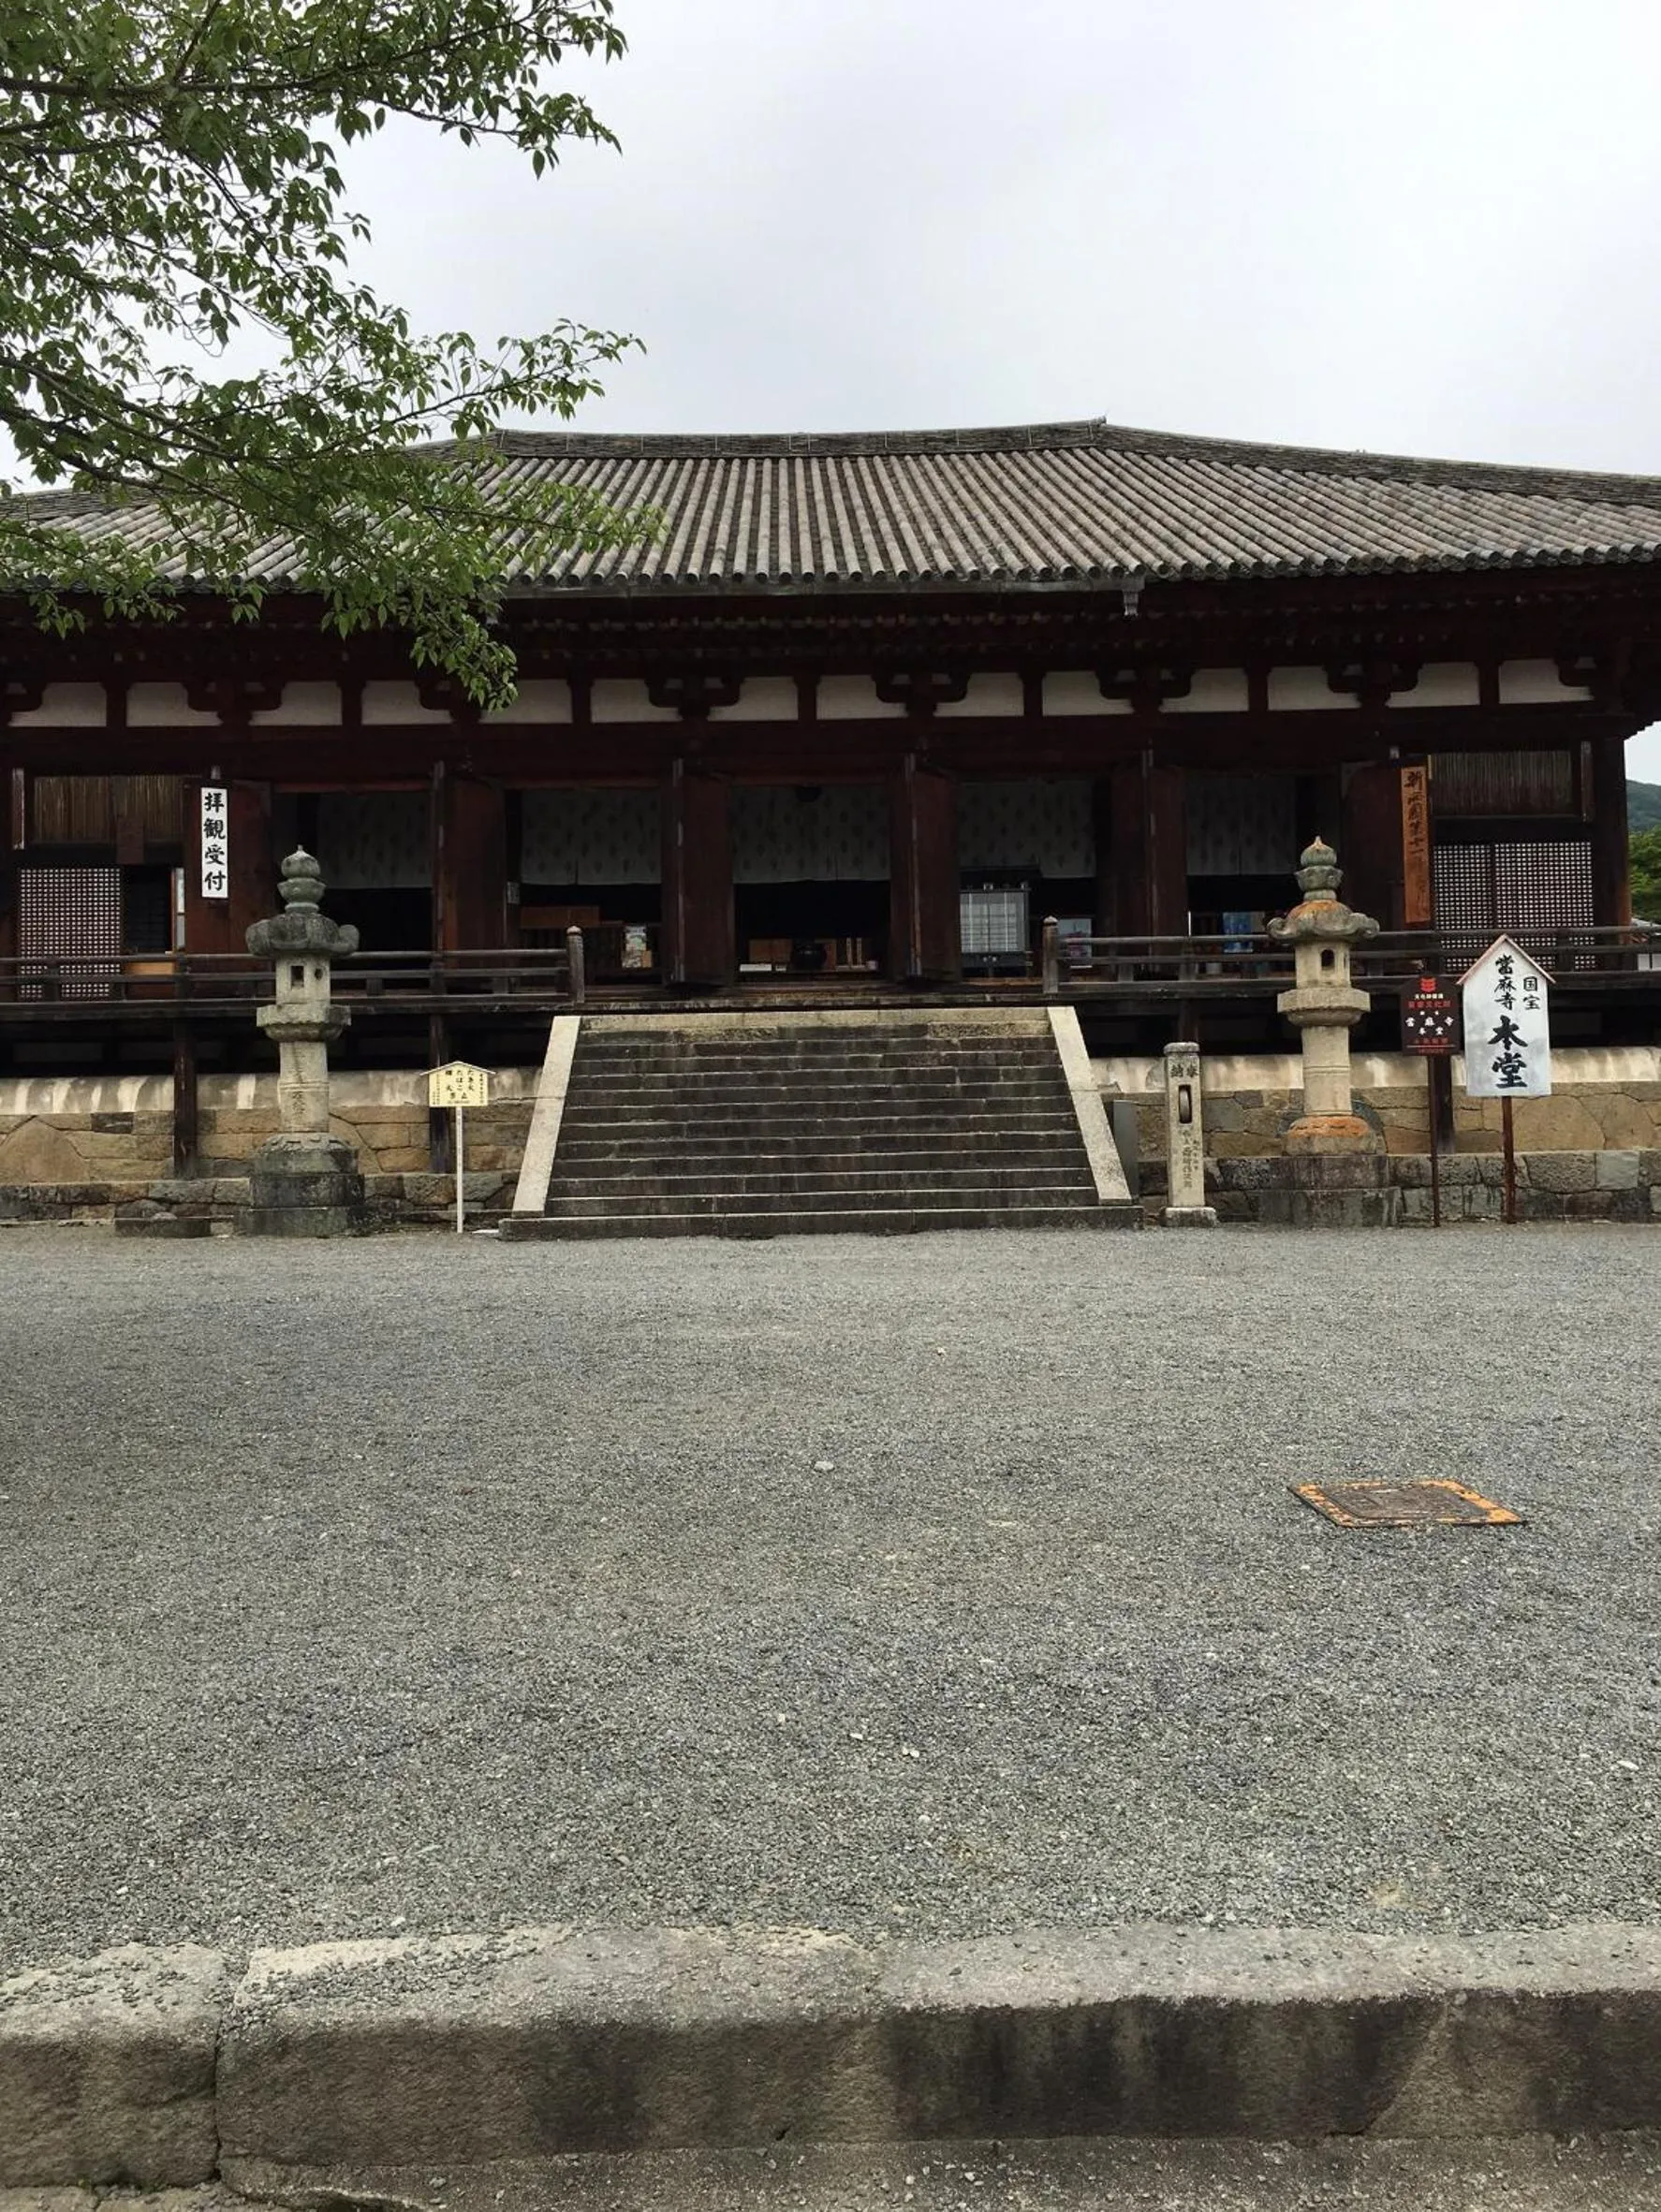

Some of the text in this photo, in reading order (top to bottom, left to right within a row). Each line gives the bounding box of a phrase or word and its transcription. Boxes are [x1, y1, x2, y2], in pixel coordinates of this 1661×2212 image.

[203, 792, 227, 891] 拝観受付
[1487, 954, 1529, 1090] 當麻寺 本堂
[1522, 975, 1541, 1011] 国宝
